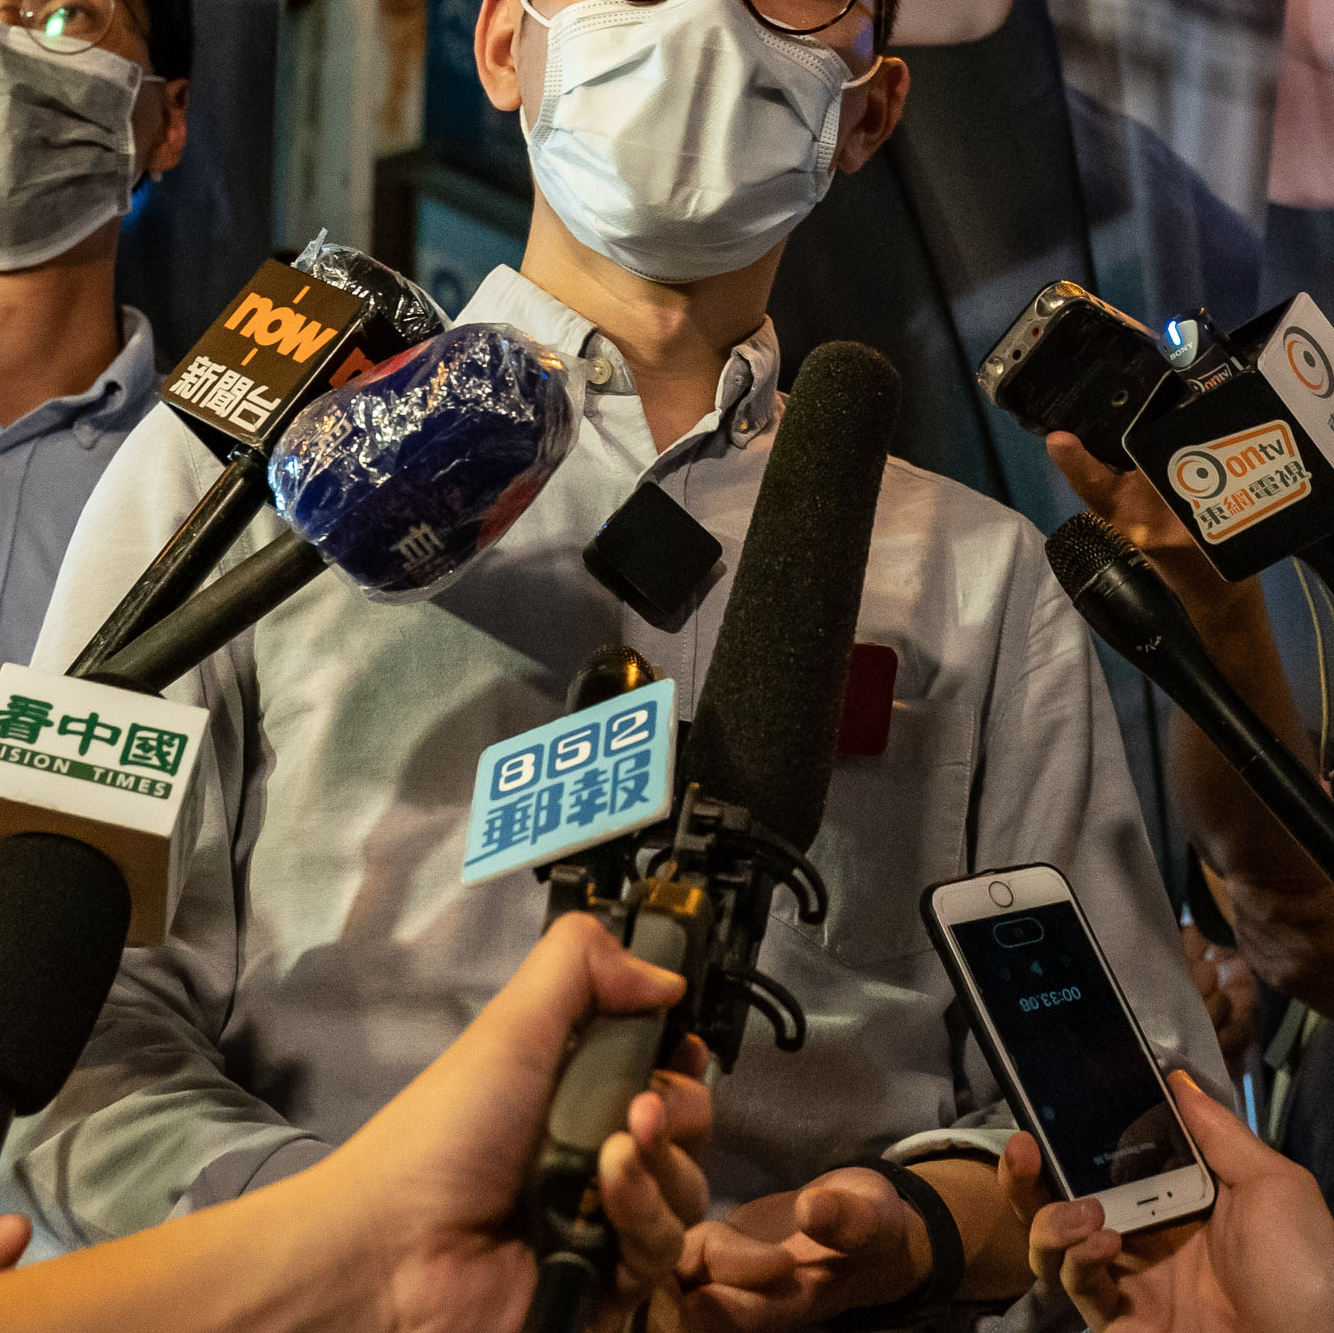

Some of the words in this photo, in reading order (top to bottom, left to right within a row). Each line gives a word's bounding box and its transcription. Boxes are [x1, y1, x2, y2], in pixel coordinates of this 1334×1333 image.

[223, 292, 339, 364] now
[1169, 341, 1194, 361] SONY
[169, 356, 281, 434] 新聞台
[1225, 439, 1285, 478] ontv
[1197, 460, 1310, 530] 東網電視
[92, 767, 168, 797] TIMES
[498, 709, 650, 793] 852
[465, 749, 652, 866] 郵報
